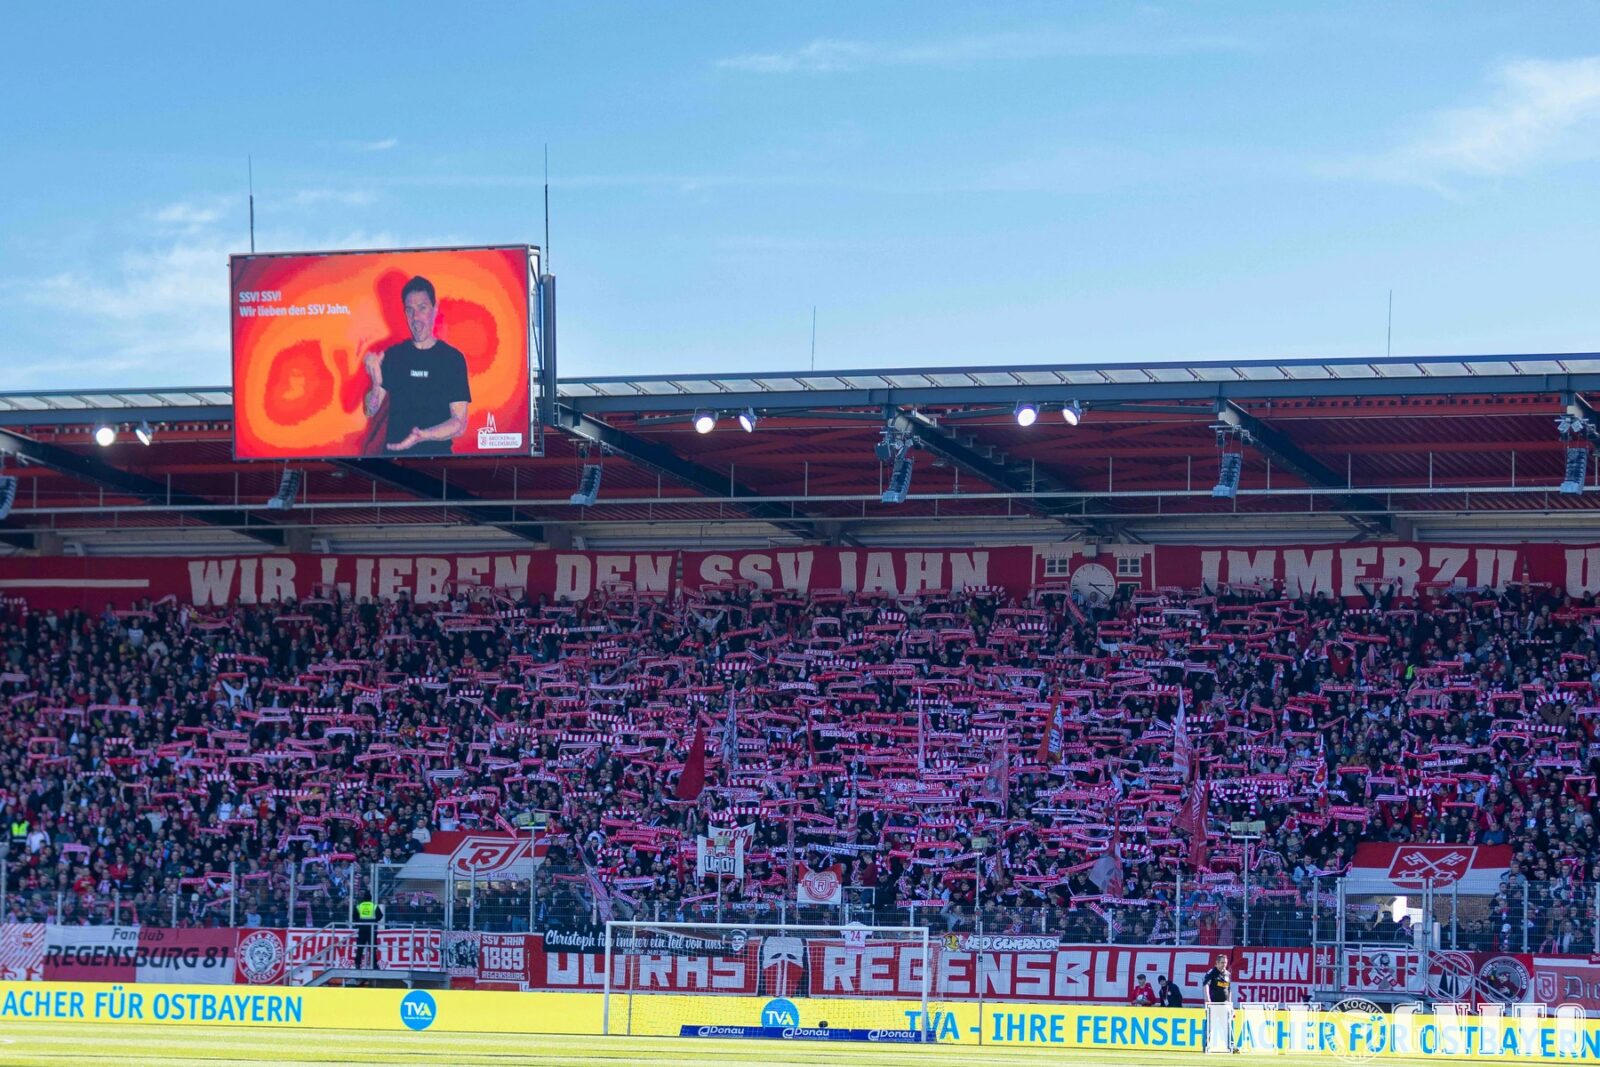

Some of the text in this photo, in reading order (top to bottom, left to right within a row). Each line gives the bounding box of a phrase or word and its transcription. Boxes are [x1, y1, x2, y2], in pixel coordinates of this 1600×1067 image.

[239, 290, 281, 302] SSV! SSV!
[239, 303, 351, 317] Wir lieben den SSV Jahn,
[188, 551, 989, 606] WIR LIEBEN DEN SSV JAHN
[112, 927, 164, 942] Fanclub
[482, 935, 525, 946] SSV JAHN
[545, 929, 596, 951] Christoph
[46, 944, 198, 971] REGENSBURG
[203, 946, 229, 969] 81
[482, 947, 524, 970] 1889
[1238, 951, 1310, 982] JAHN
[482, 971, 525, 980] REGENSBURG
[1238, 984, 1310, 1003] STADION
[2, 985, 302, 1023] ACHER FÜR OSTBAYERN
[404, 1001, 432, 1016] TVA
[765, 1010, 794, 1026] TVA
[710, 1025, 744, 1035] Donau
[795, 1027, 829, 1037] Donau
[880, 1029, 915, 1038] Donau
[992, 1012, 1065, 1042] IHRE
